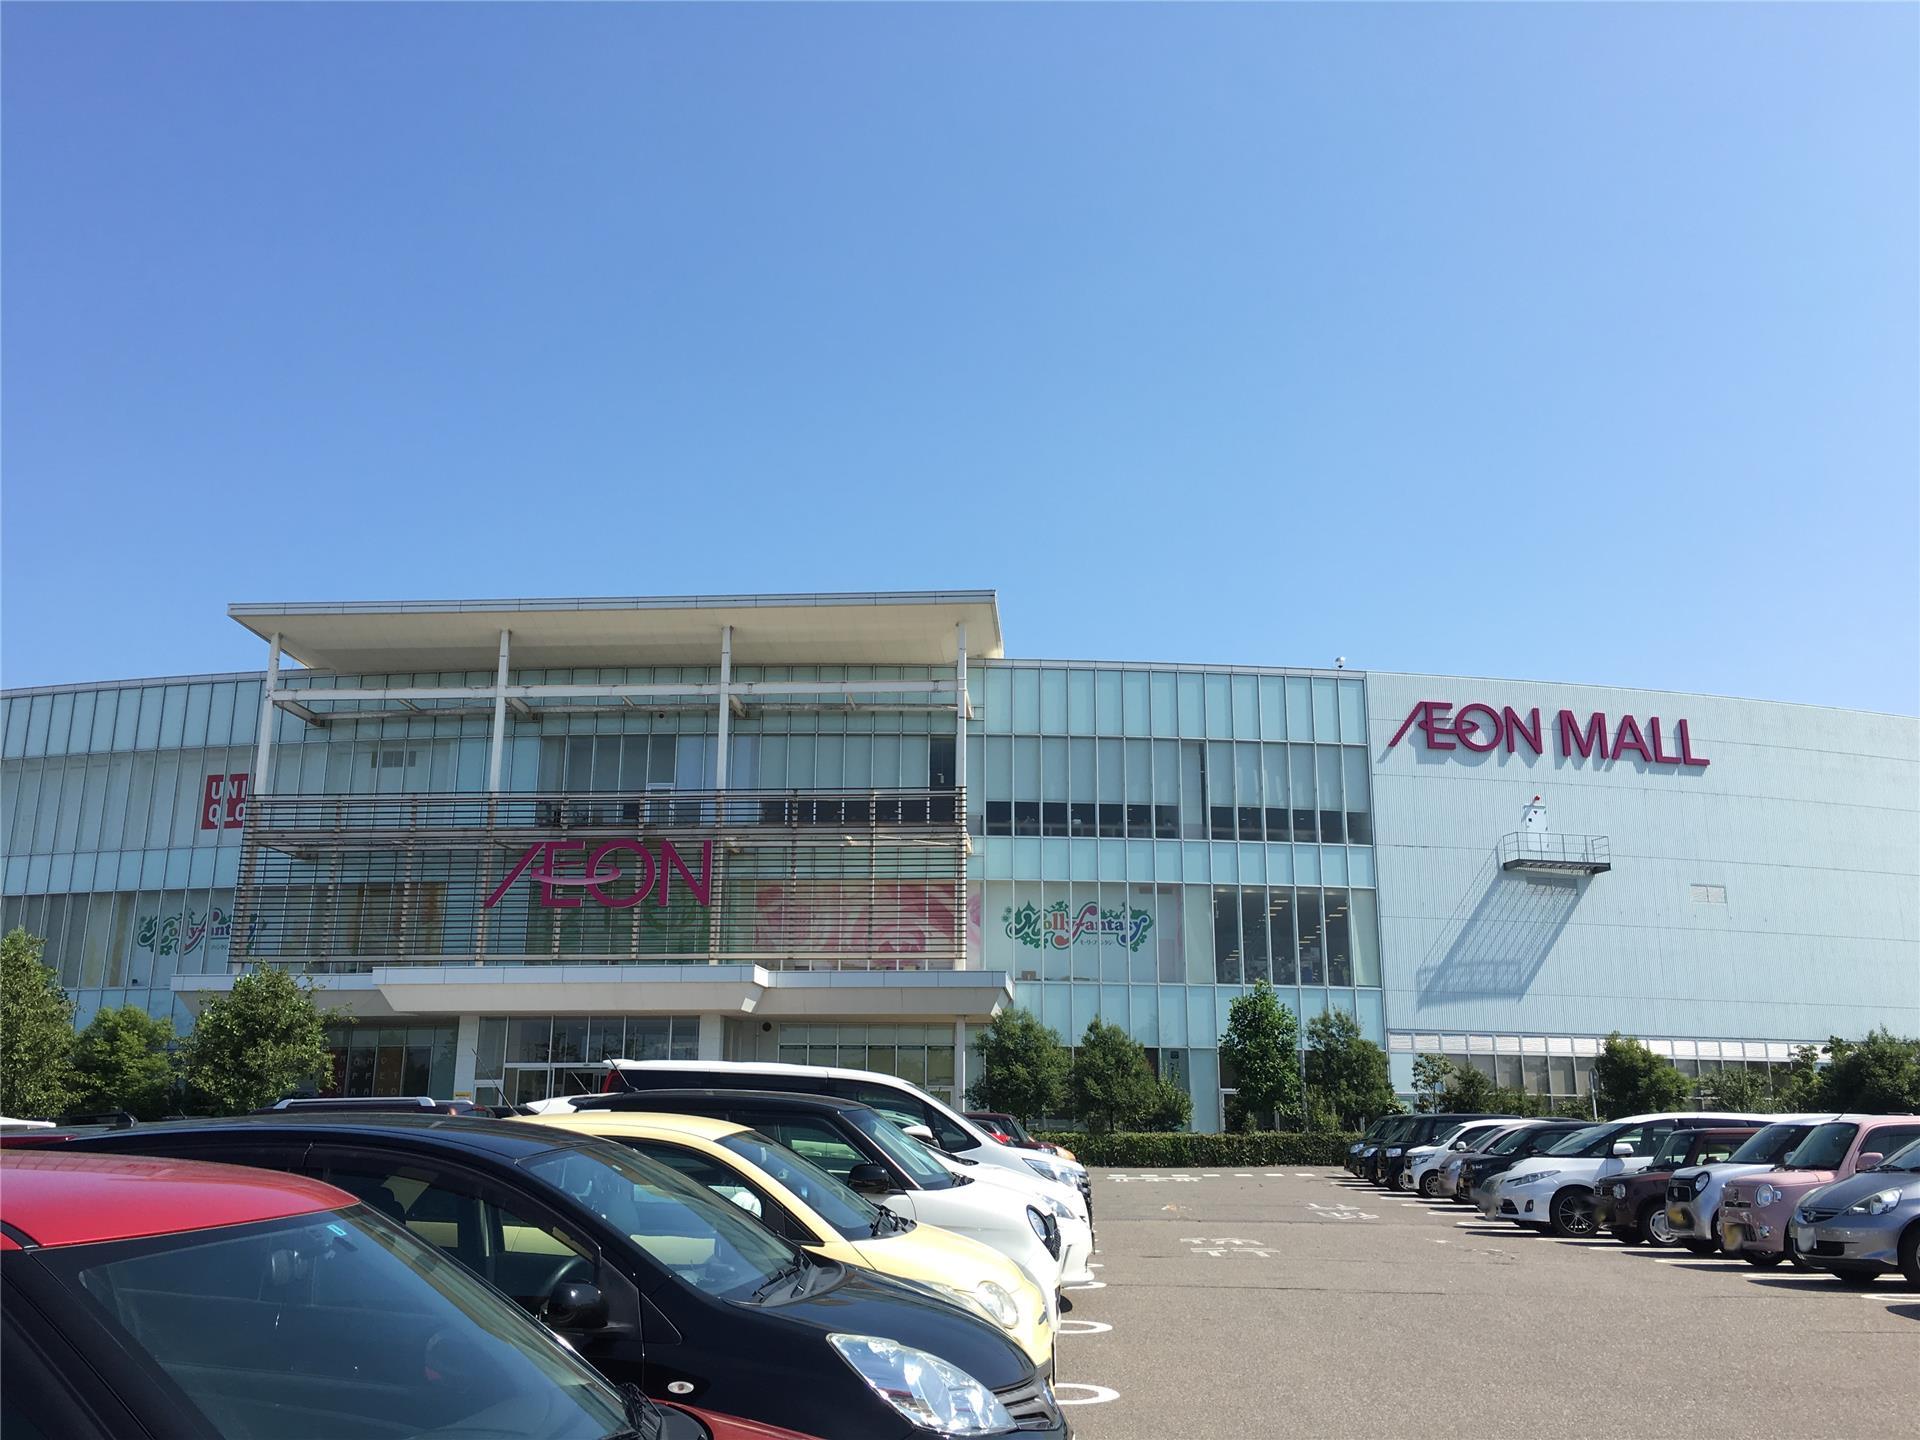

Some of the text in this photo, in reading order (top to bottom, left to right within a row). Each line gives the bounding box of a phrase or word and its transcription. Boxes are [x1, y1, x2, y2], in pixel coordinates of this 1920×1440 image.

[1558, 708, 1711, 767] MALL
[210, 780, 247, 800] UNI
[208, 802, 247, 826] QLO
